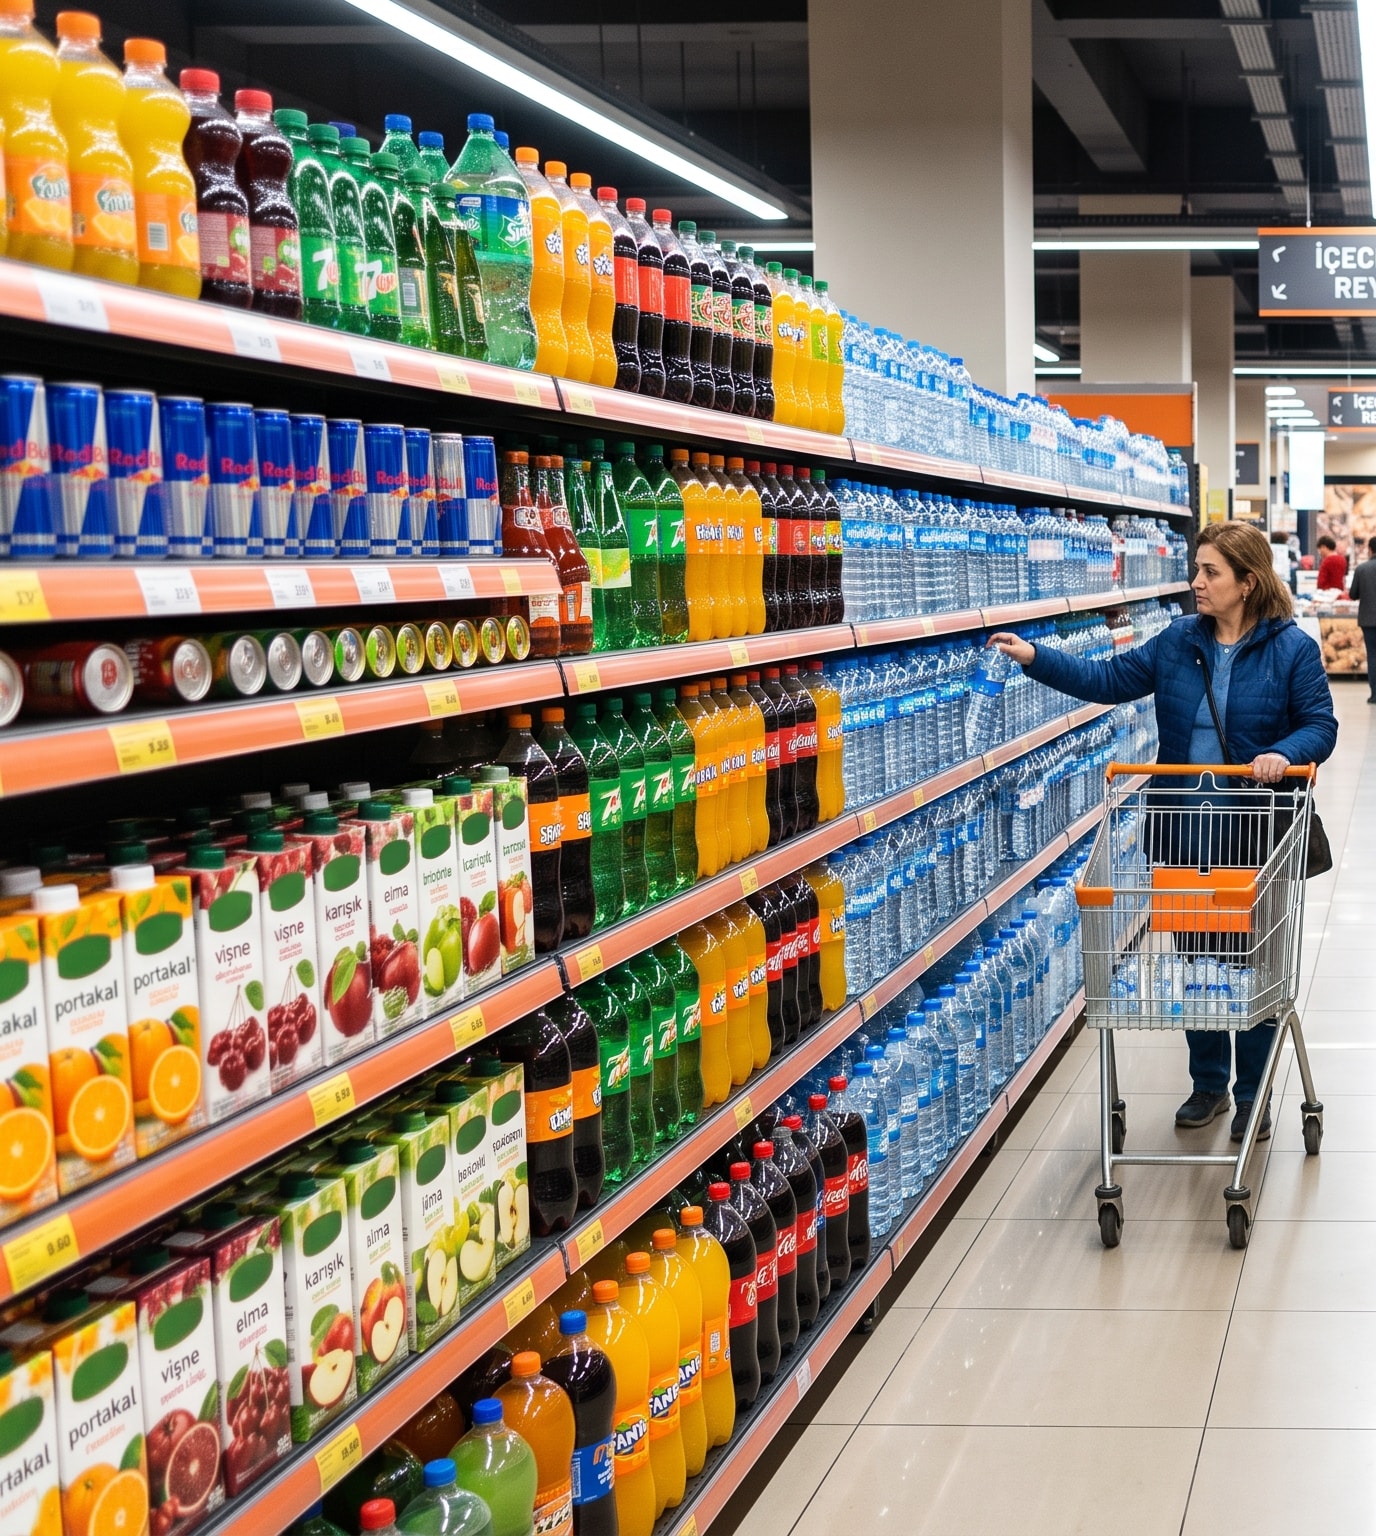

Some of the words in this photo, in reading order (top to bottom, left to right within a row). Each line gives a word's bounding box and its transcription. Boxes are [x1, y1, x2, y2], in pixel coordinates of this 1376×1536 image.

[325, 895, 363, 922] karışık
[273, 920, 304, 943] vişne
[215, 941, 251, 968] vişne
[133, 956, 191, 995] portakal
[55, 980, 118, 1022] portakal
[0, 1006, 38, 1037] akal
[305, 1252, 346, 1290] karışık
[236, 1301, 270, 1335] elma
[160, 1348, 200, 1385] vişne
[68, 1386, 138, 1451] portakal
[0, 1443, 52, 1498] rtakal
